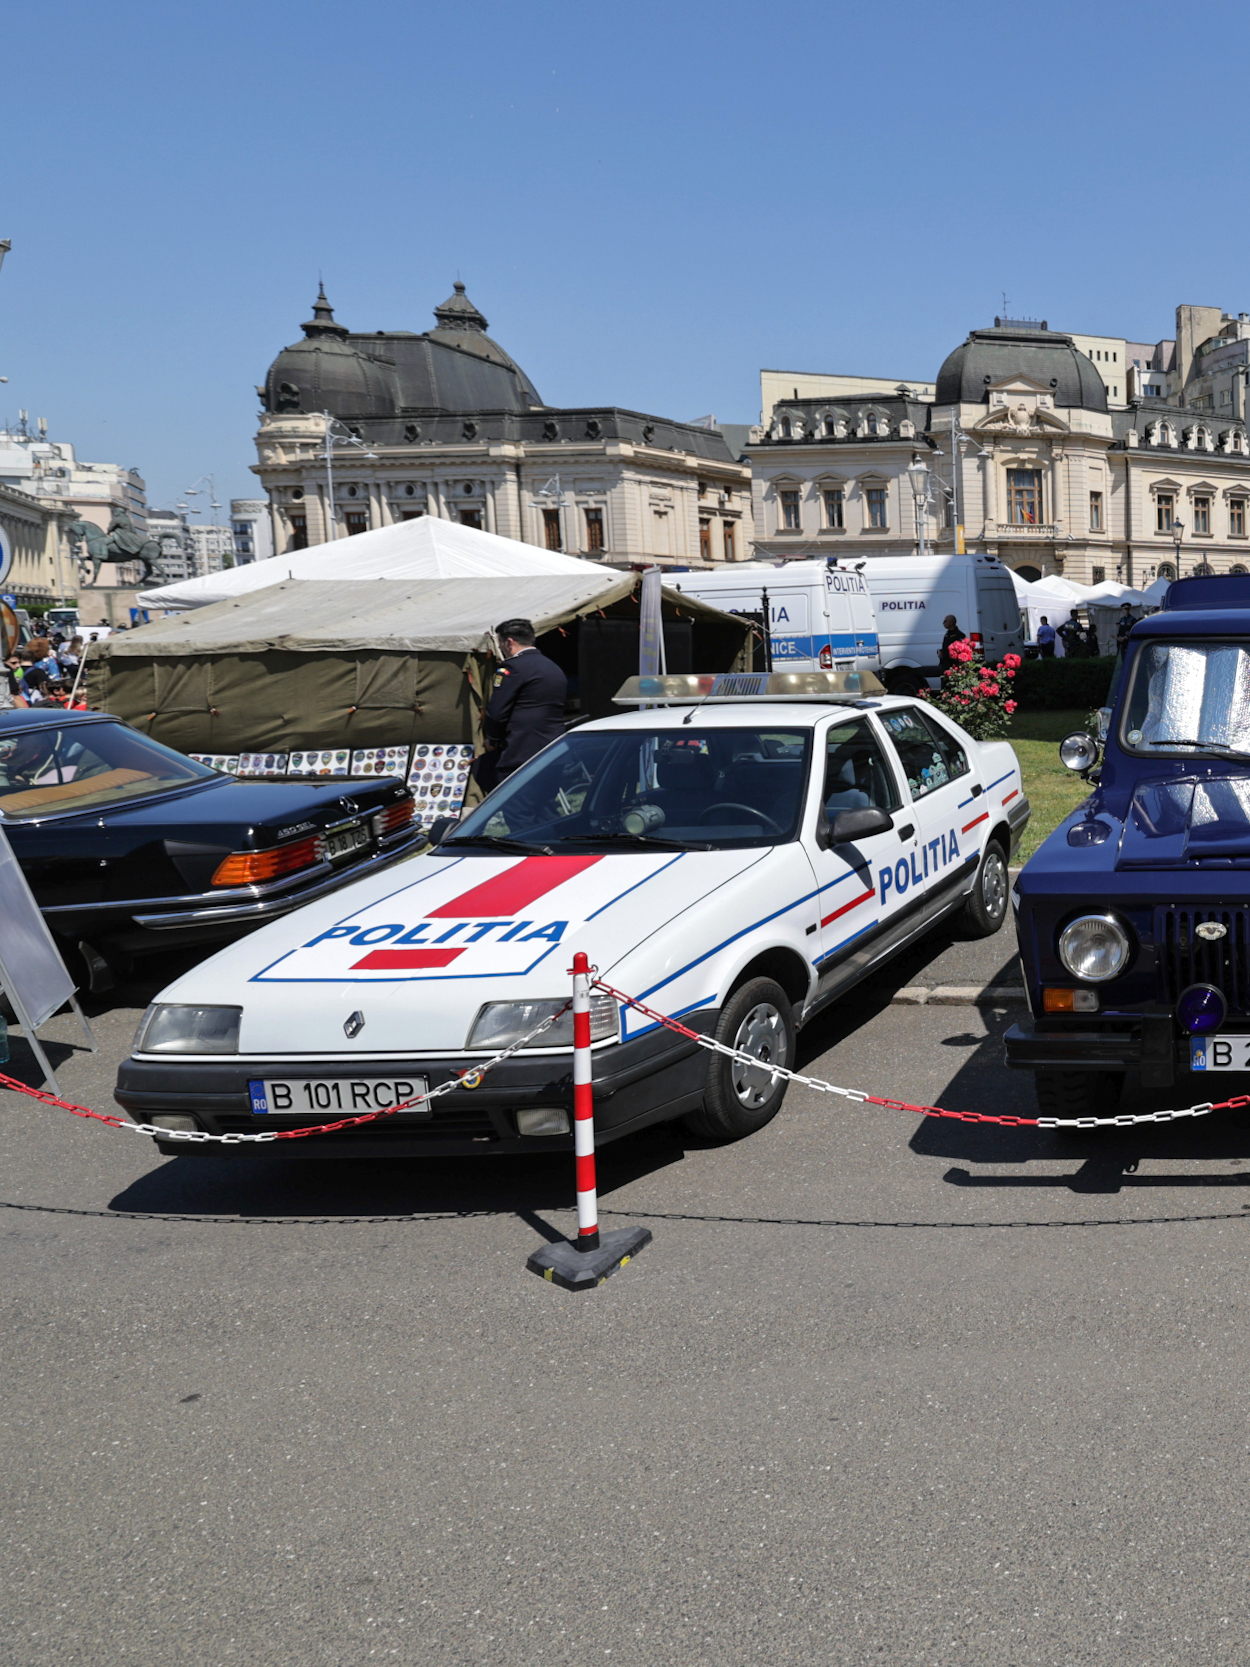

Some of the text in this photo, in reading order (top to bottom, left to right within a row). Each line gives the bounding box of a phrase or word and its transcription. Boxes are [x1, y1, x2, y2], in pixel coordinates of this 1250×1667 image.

[826, 575, 865, 592] POLITIA
[882, 601, 926, 610] POLITIA
[328, 842, 336, 856] B
[338, 834, 348, 852] 18
[879, 828, 960, 906] POLITIA
[300, 920, 569, 948] POLITIA
[1213, 1041, 1232, 1067] B
[253, 1098, 267, 1110] RO
[271, 1082, 415, 1110] B 101 RCP
